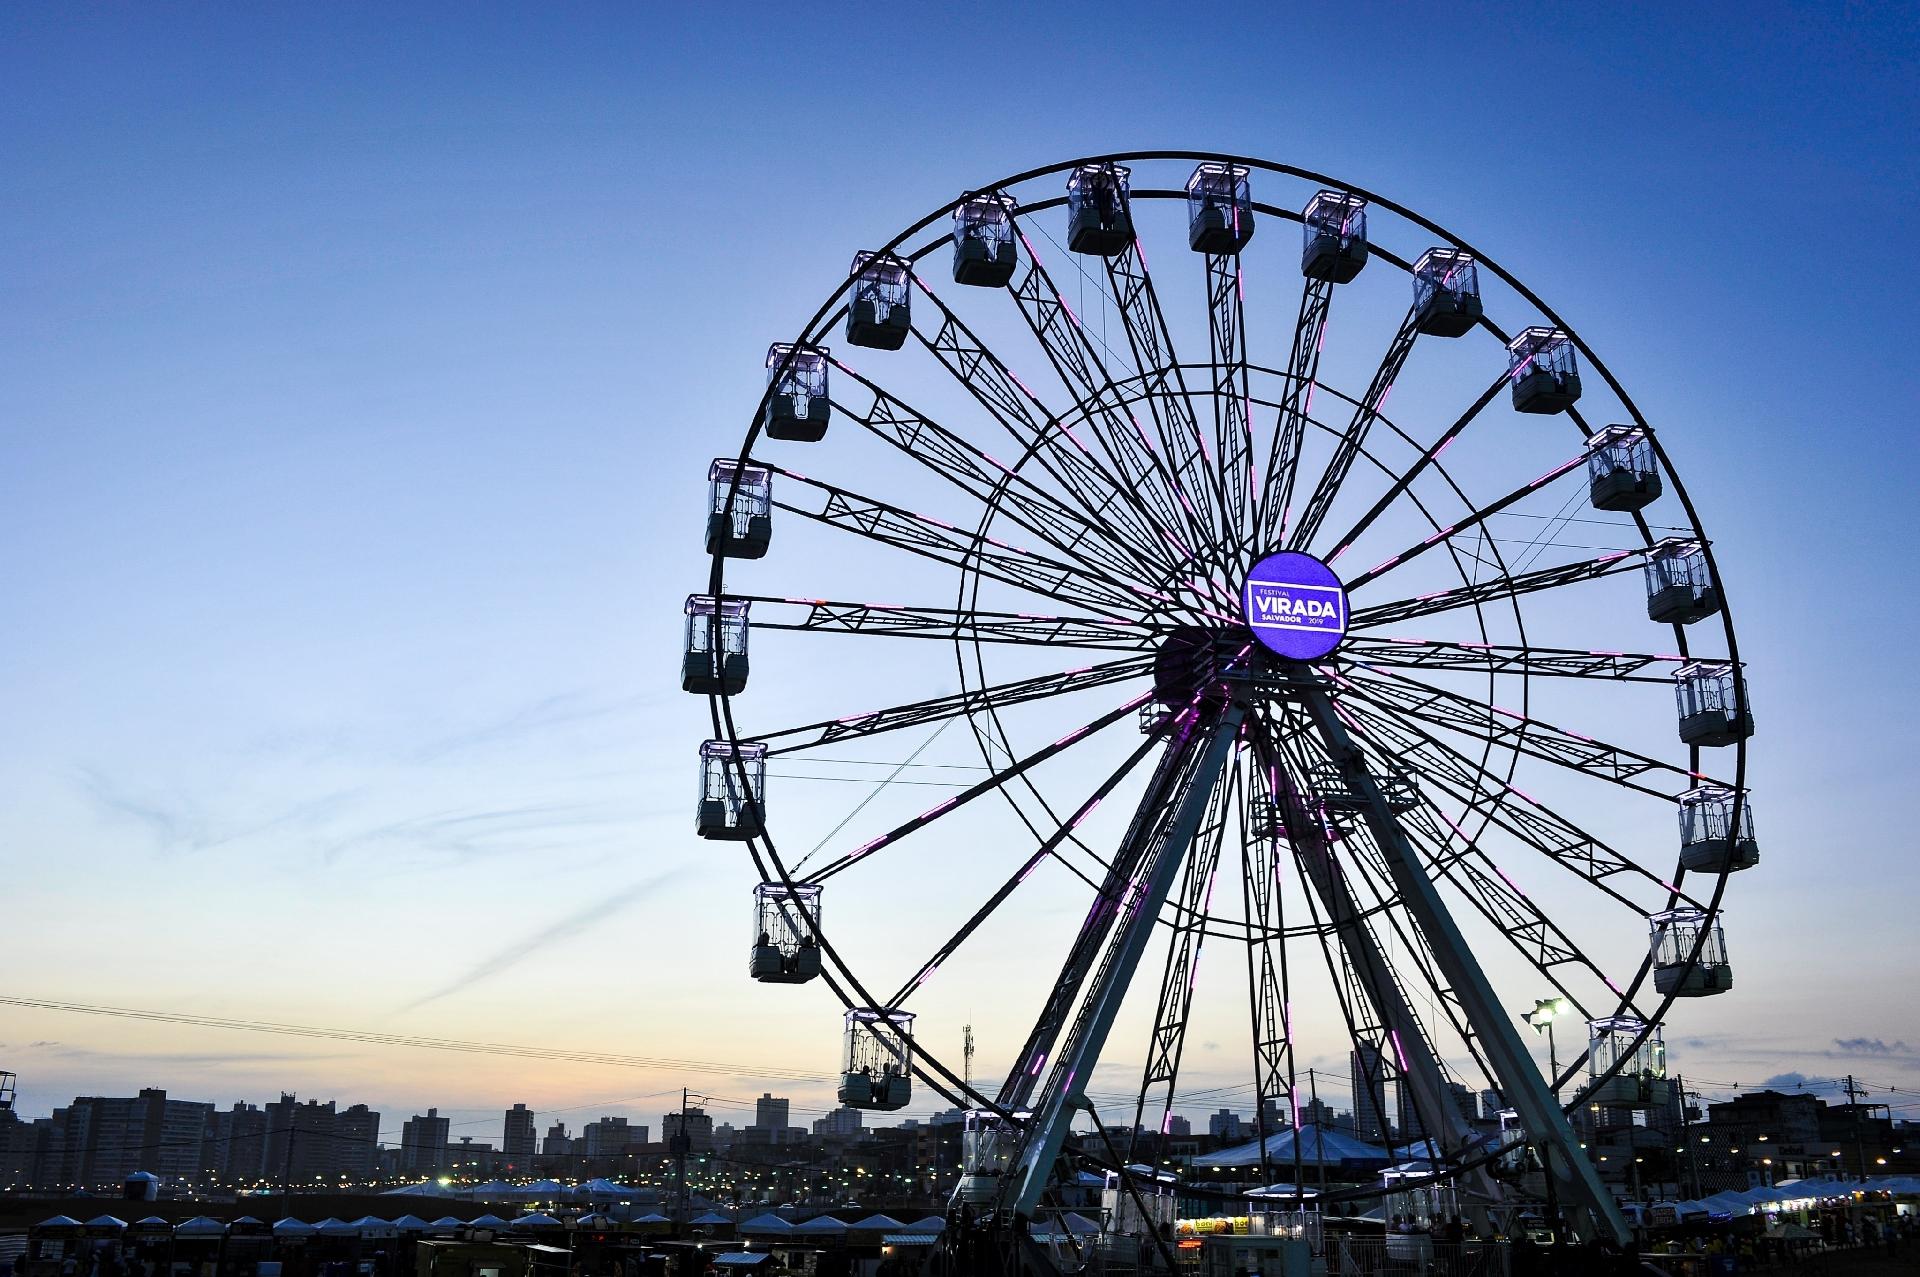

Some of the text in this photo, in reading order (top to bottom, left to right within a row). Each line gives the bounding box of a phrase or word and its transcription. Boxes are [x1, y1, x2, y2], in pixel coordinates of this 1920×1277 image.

[1260, 589, 1289, 597] FESTIVAL
[1256, 595, 1337, 618] VIRADA
[1262, 614, 1301, 623] SALVADOR
